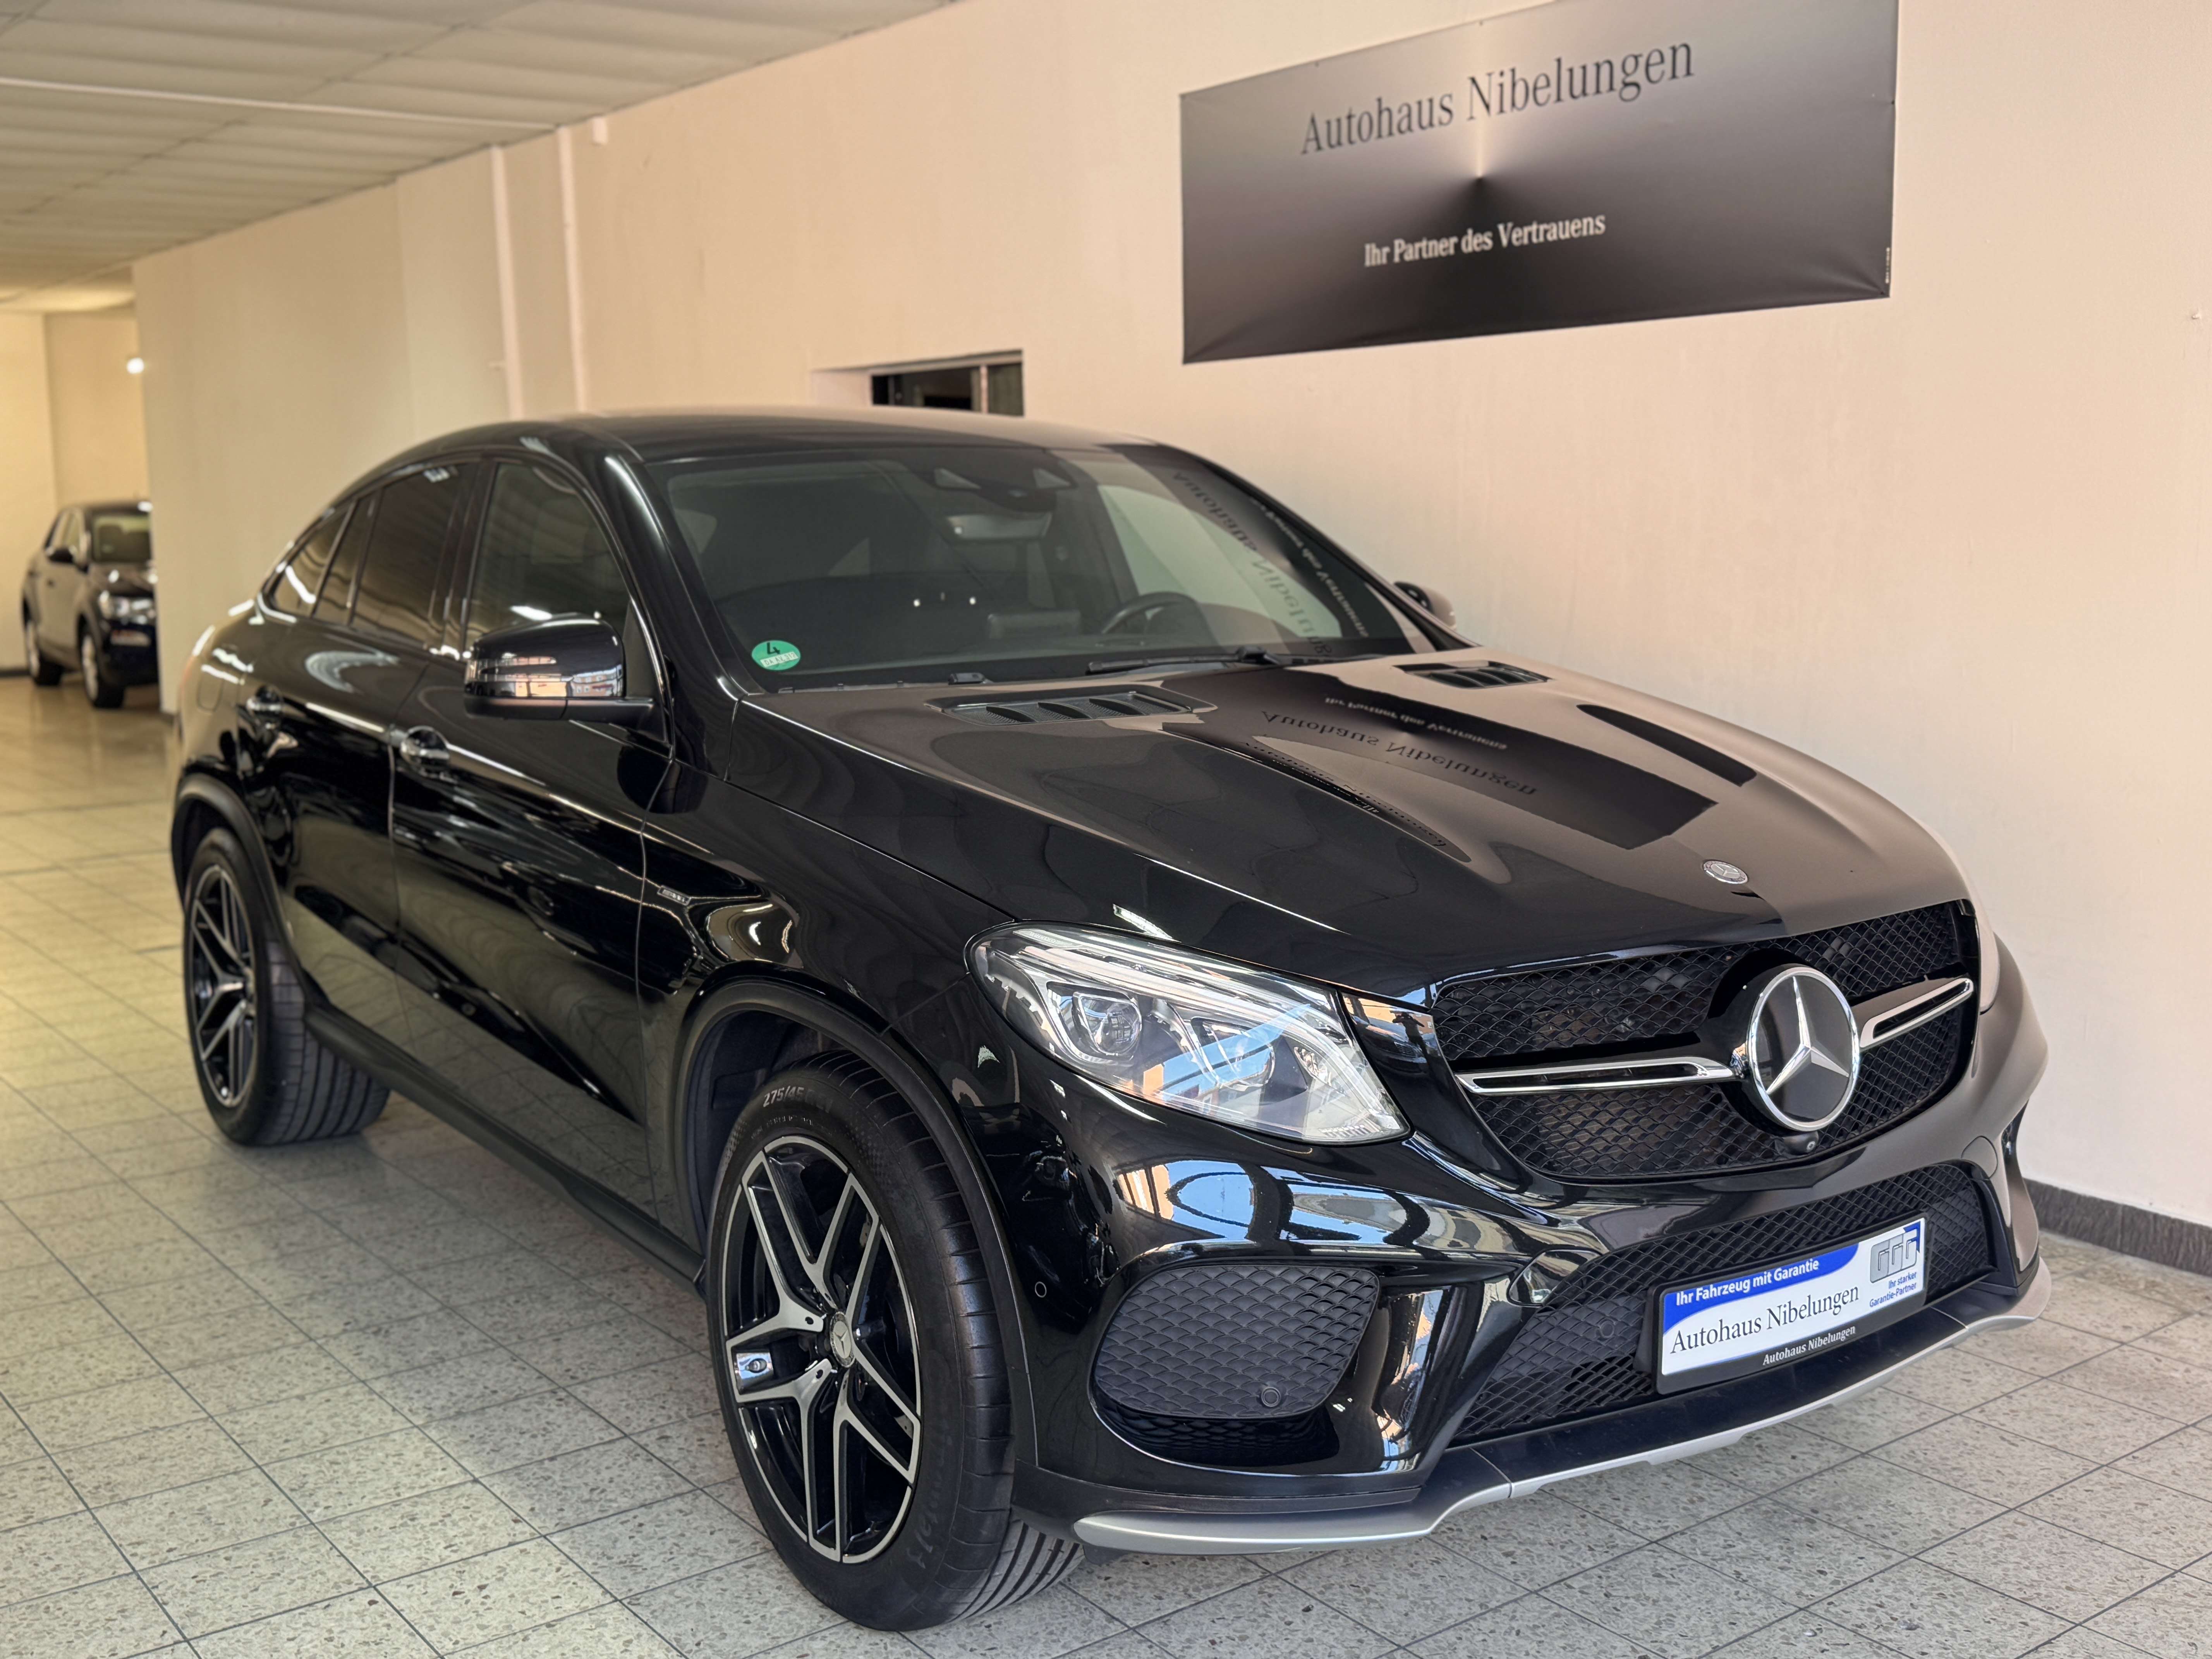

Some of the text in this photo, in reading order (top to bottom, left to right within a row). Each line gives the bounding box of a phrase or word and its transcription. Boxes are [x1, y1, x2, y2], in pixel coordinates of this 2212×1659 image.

[1301, 42, 1695, 155] Autohaus Nibelungen
[1364, 215, 1606, 267] Ihr Partner des Vertrauens
[767, 642, 781, 654] 4
[763, 1085, 804, 1108] 275/45
[1676, 1258, 1820, 1306] Ihr Fahrzeug mit Garantie
[1869, 1282, 1917, 1308] Garantie-Partner
[1888, 1271, 1917, 1289] Ihr starker
[1670, 1286, 1859, 1354] Autohaus Nibelungen
[1762, 1325, 1856, 1366] Autohaus Nibelungen
